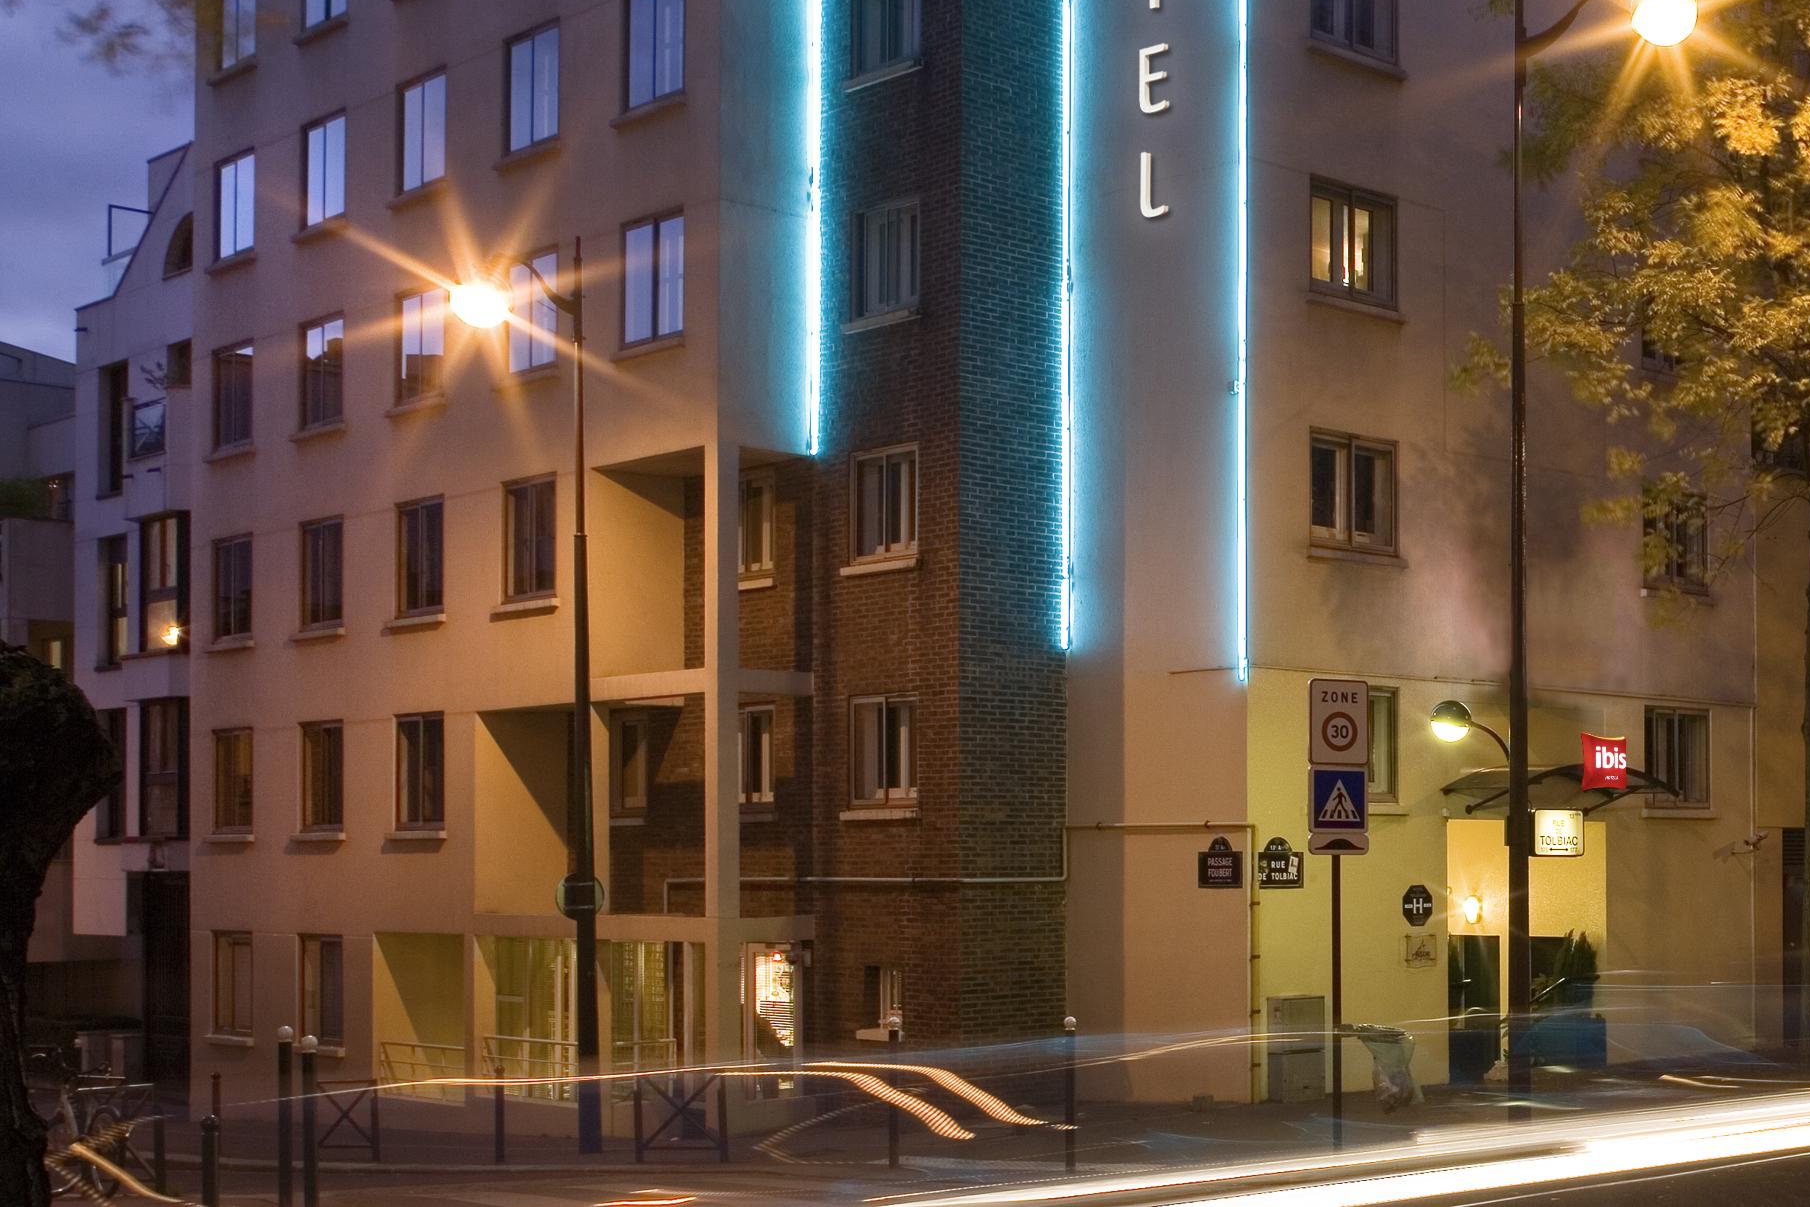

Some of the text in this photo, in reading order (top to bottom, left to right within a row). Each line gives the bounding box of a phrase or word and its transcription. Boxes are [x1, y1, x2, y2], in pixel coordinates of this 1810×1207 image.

[1321, 691, 1358, 704] ZONE
[1331, 725, 1349, 739] 30
[1595, 746, 1627, 769] ibis
[1539, 835, 1578, 846] TOLBIAC
[1207, 857, 1232, 866] PASSAGE
[1271, 860, 1286, 869] RUE
[1271, 872, 1298, 881] TOLBIAC
[1413, 898, 1423, 914] H
